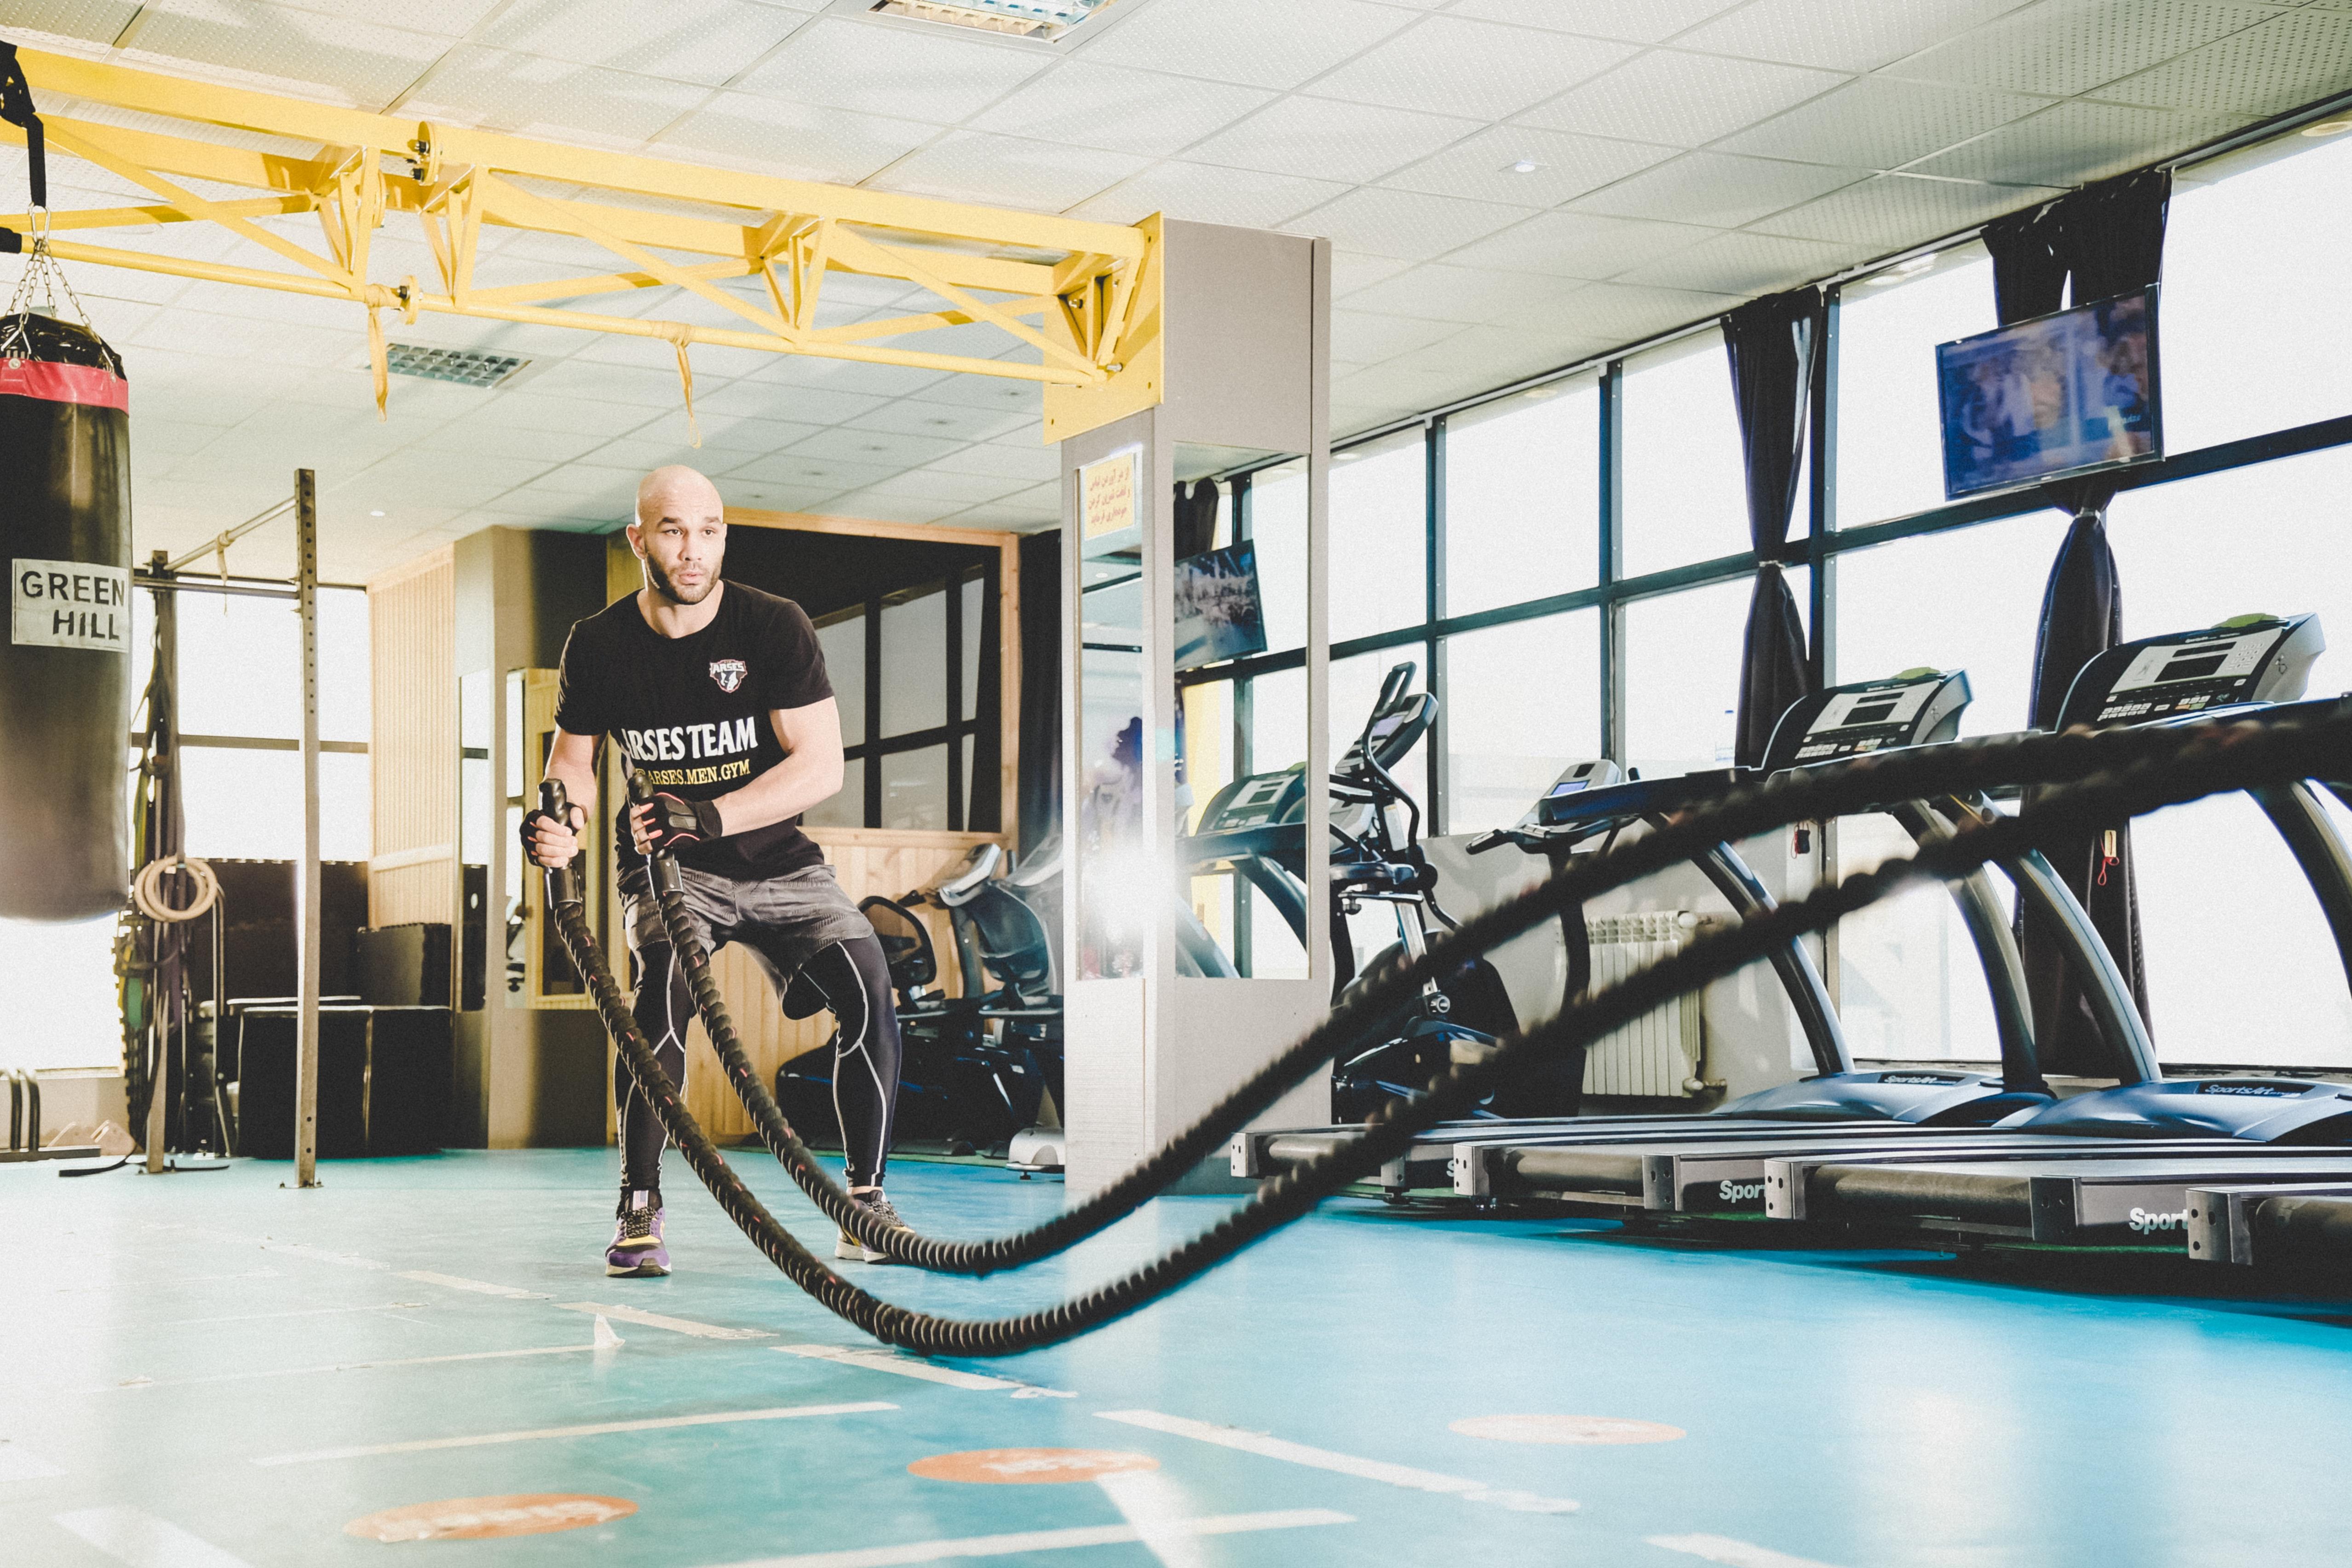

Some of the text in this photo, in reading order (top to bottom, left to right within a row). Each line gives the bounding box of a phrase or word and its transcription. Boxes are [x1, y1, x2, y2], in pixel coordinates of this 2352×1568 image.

[21, 570, 125, 607] GREEN
[52, 609, 120, 641] HILL
[712, 662, 745, 674] ARSES
[686, 716, 759, 759] TEAM
[2205, 1084, 2274, 1095] SportsArt
